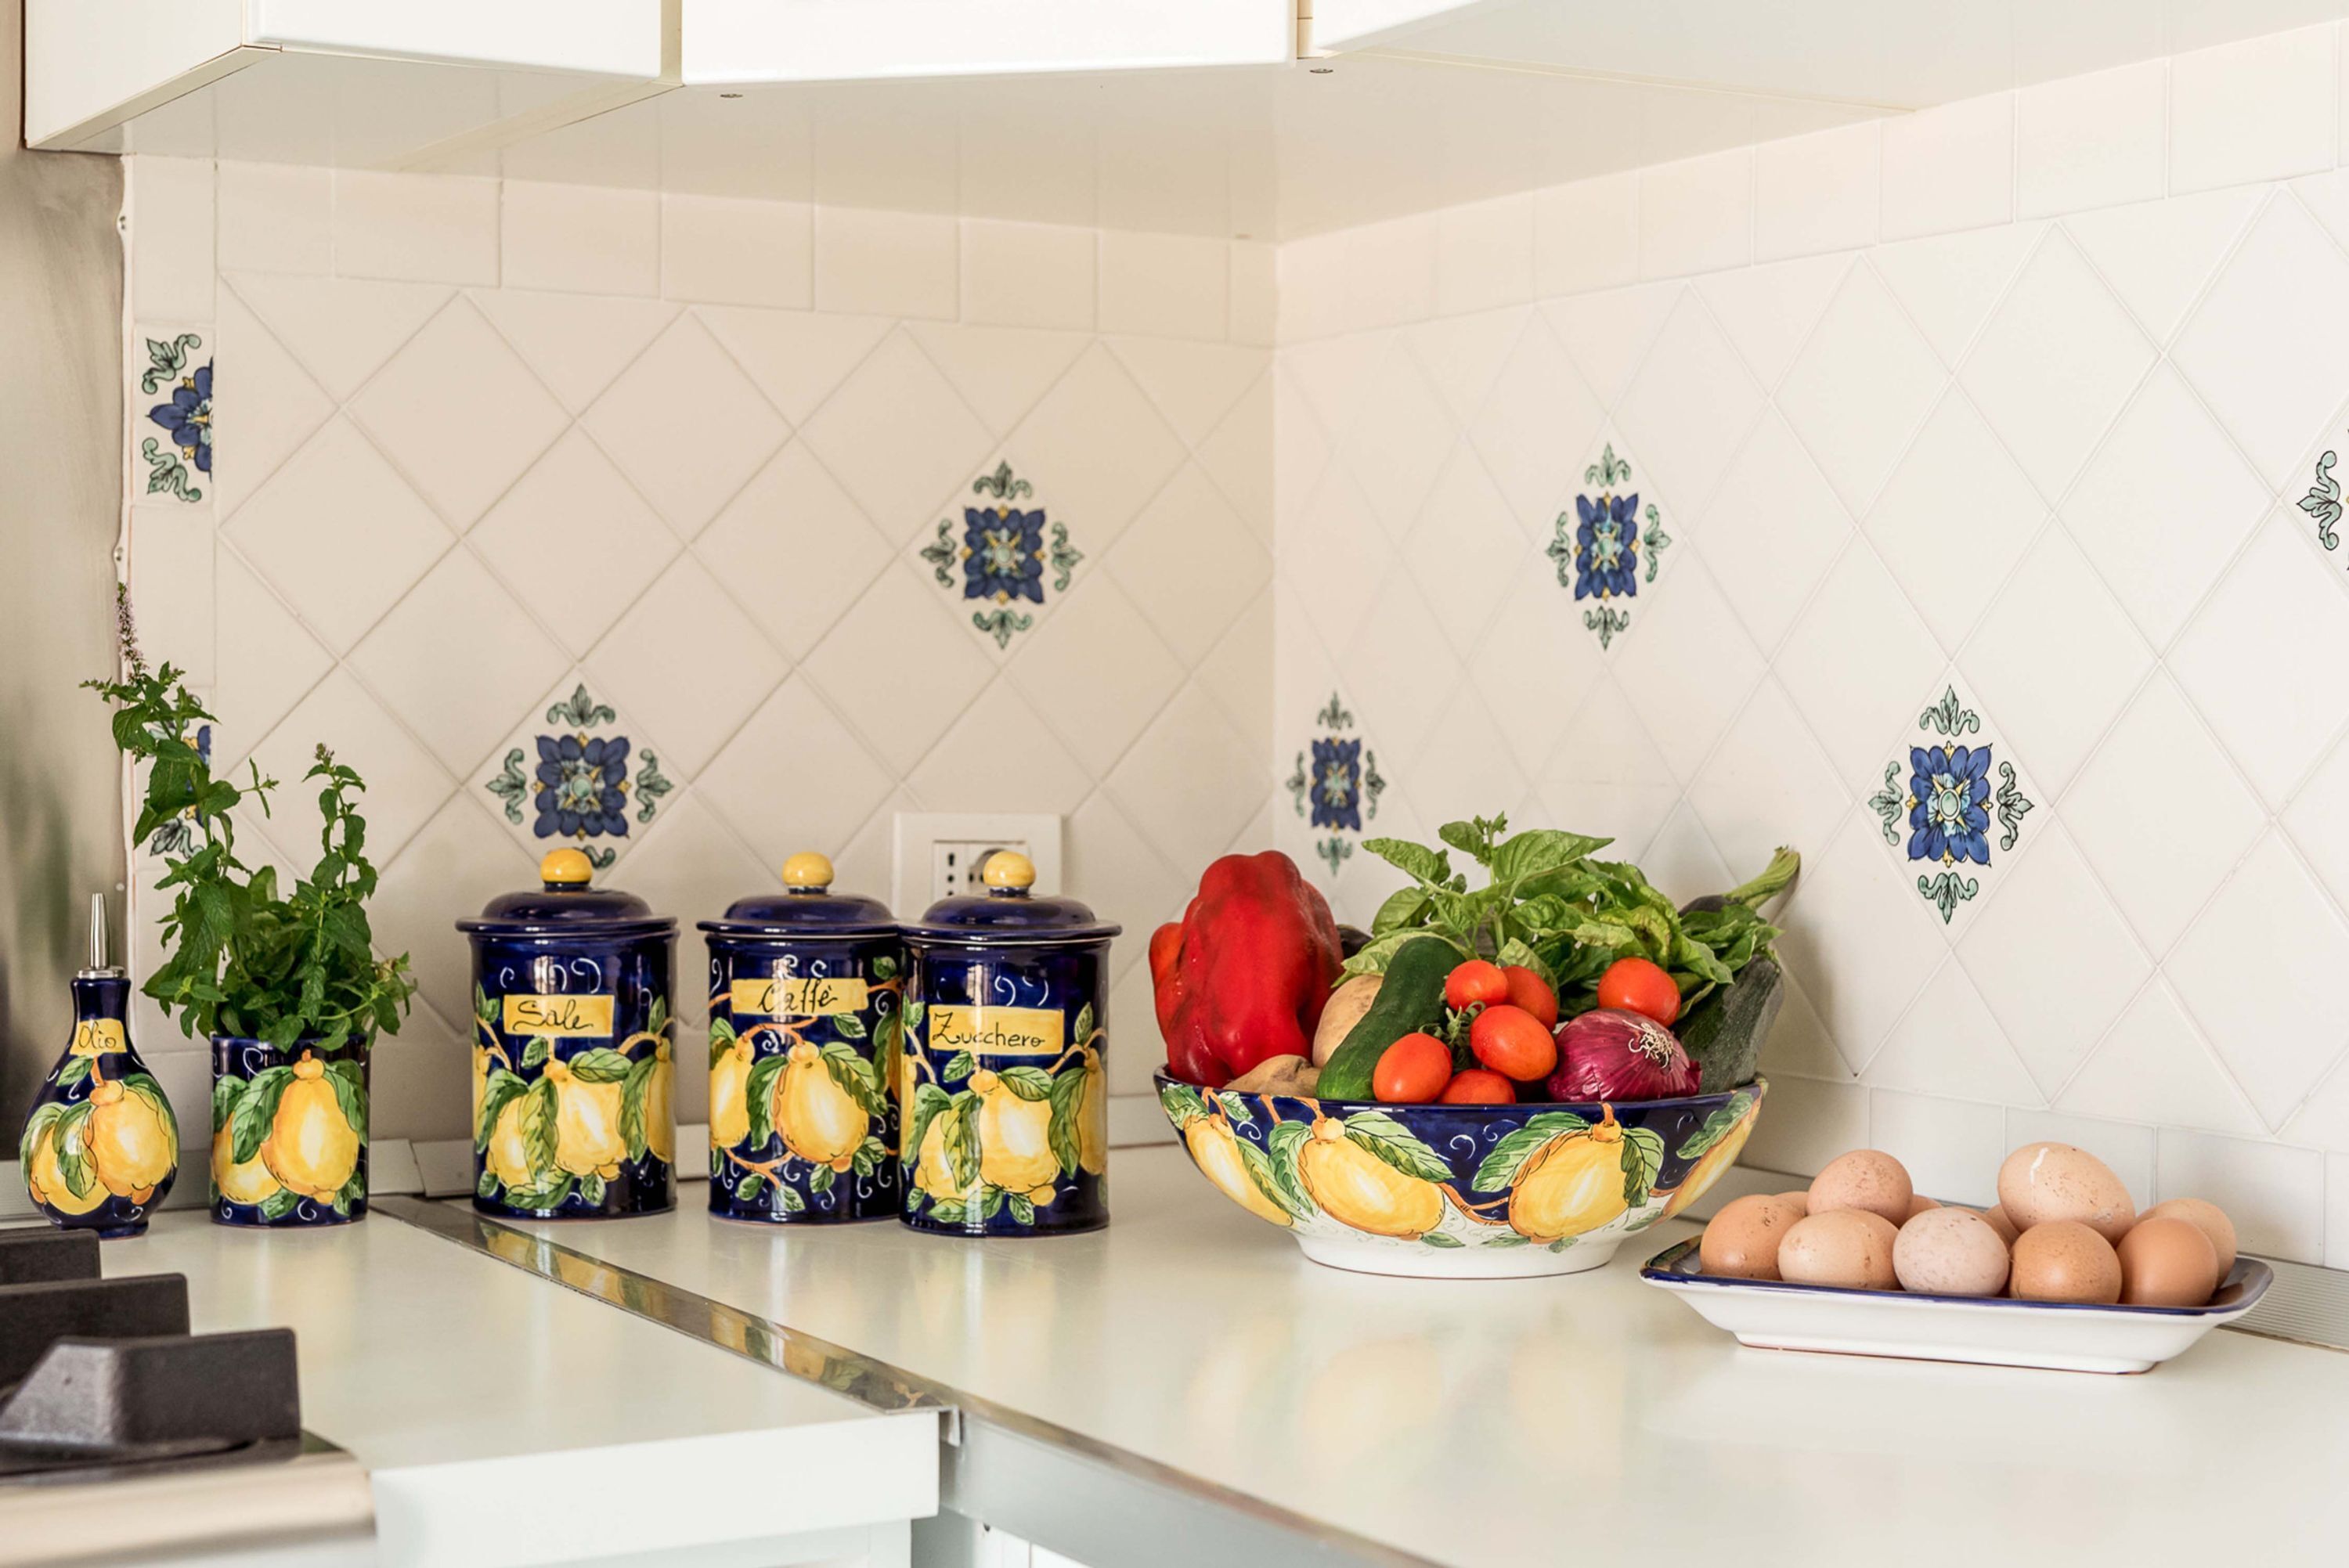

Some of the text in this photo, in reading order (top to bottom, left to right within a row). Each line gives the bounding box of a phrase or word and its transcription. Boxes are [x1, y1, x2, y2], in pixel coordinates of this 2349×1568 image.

[513, 999, 594, 1031] Sale
[932, 1011, 1045, 1047] Zucchero
[78, 1021, 117, 1049] Olio
